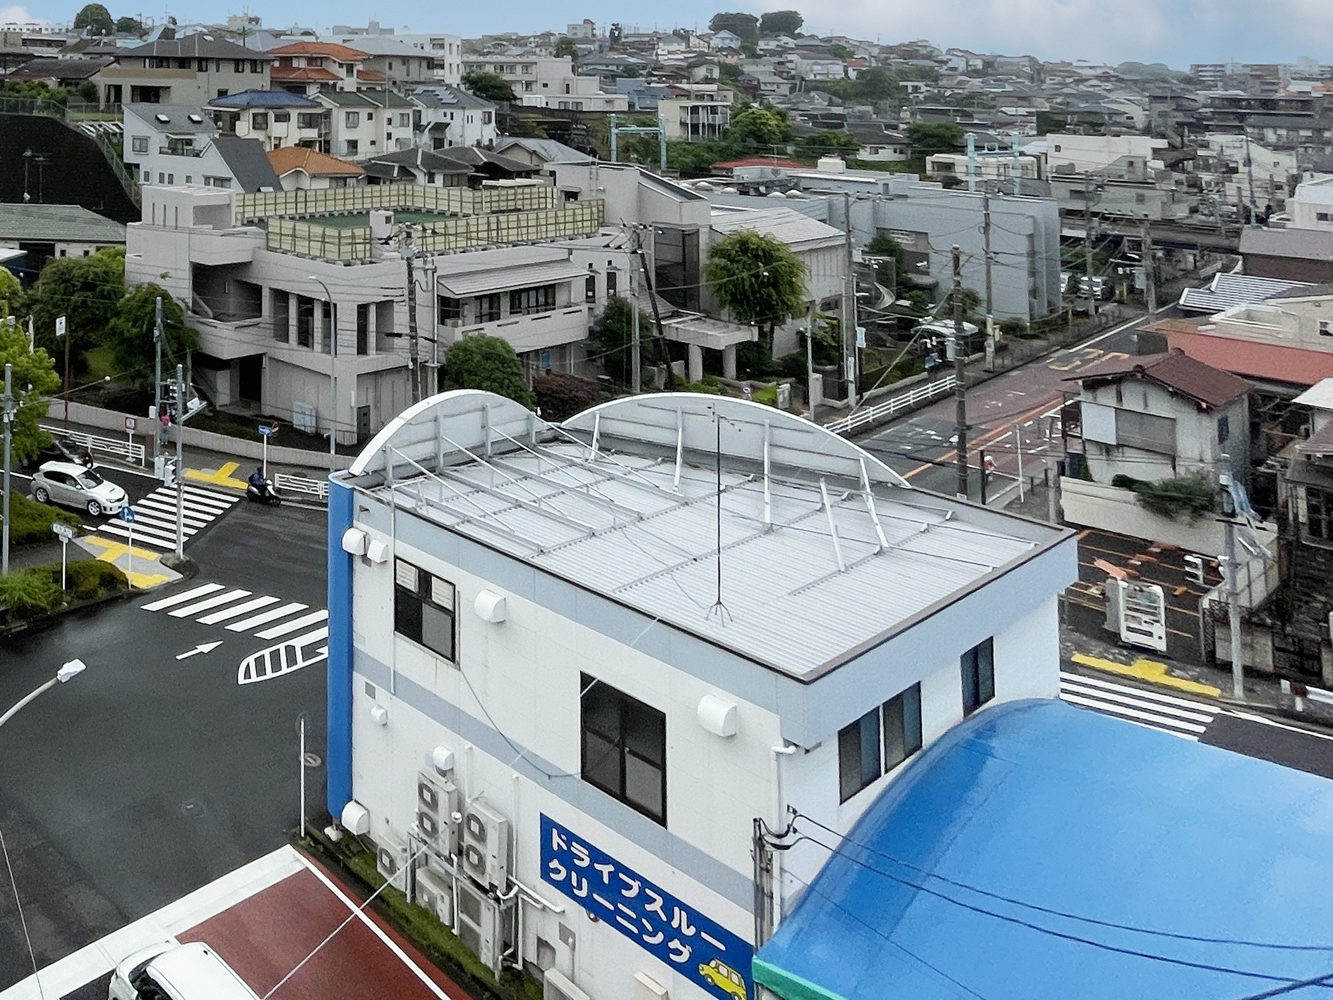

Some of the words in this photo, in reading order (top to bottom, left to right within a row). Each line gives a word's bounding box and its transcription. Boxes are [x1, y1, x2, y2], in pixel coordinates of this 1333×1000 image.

[548, 858, 693, 963] クリーニング
[551, 827, 726, 951] ドライブスルー
